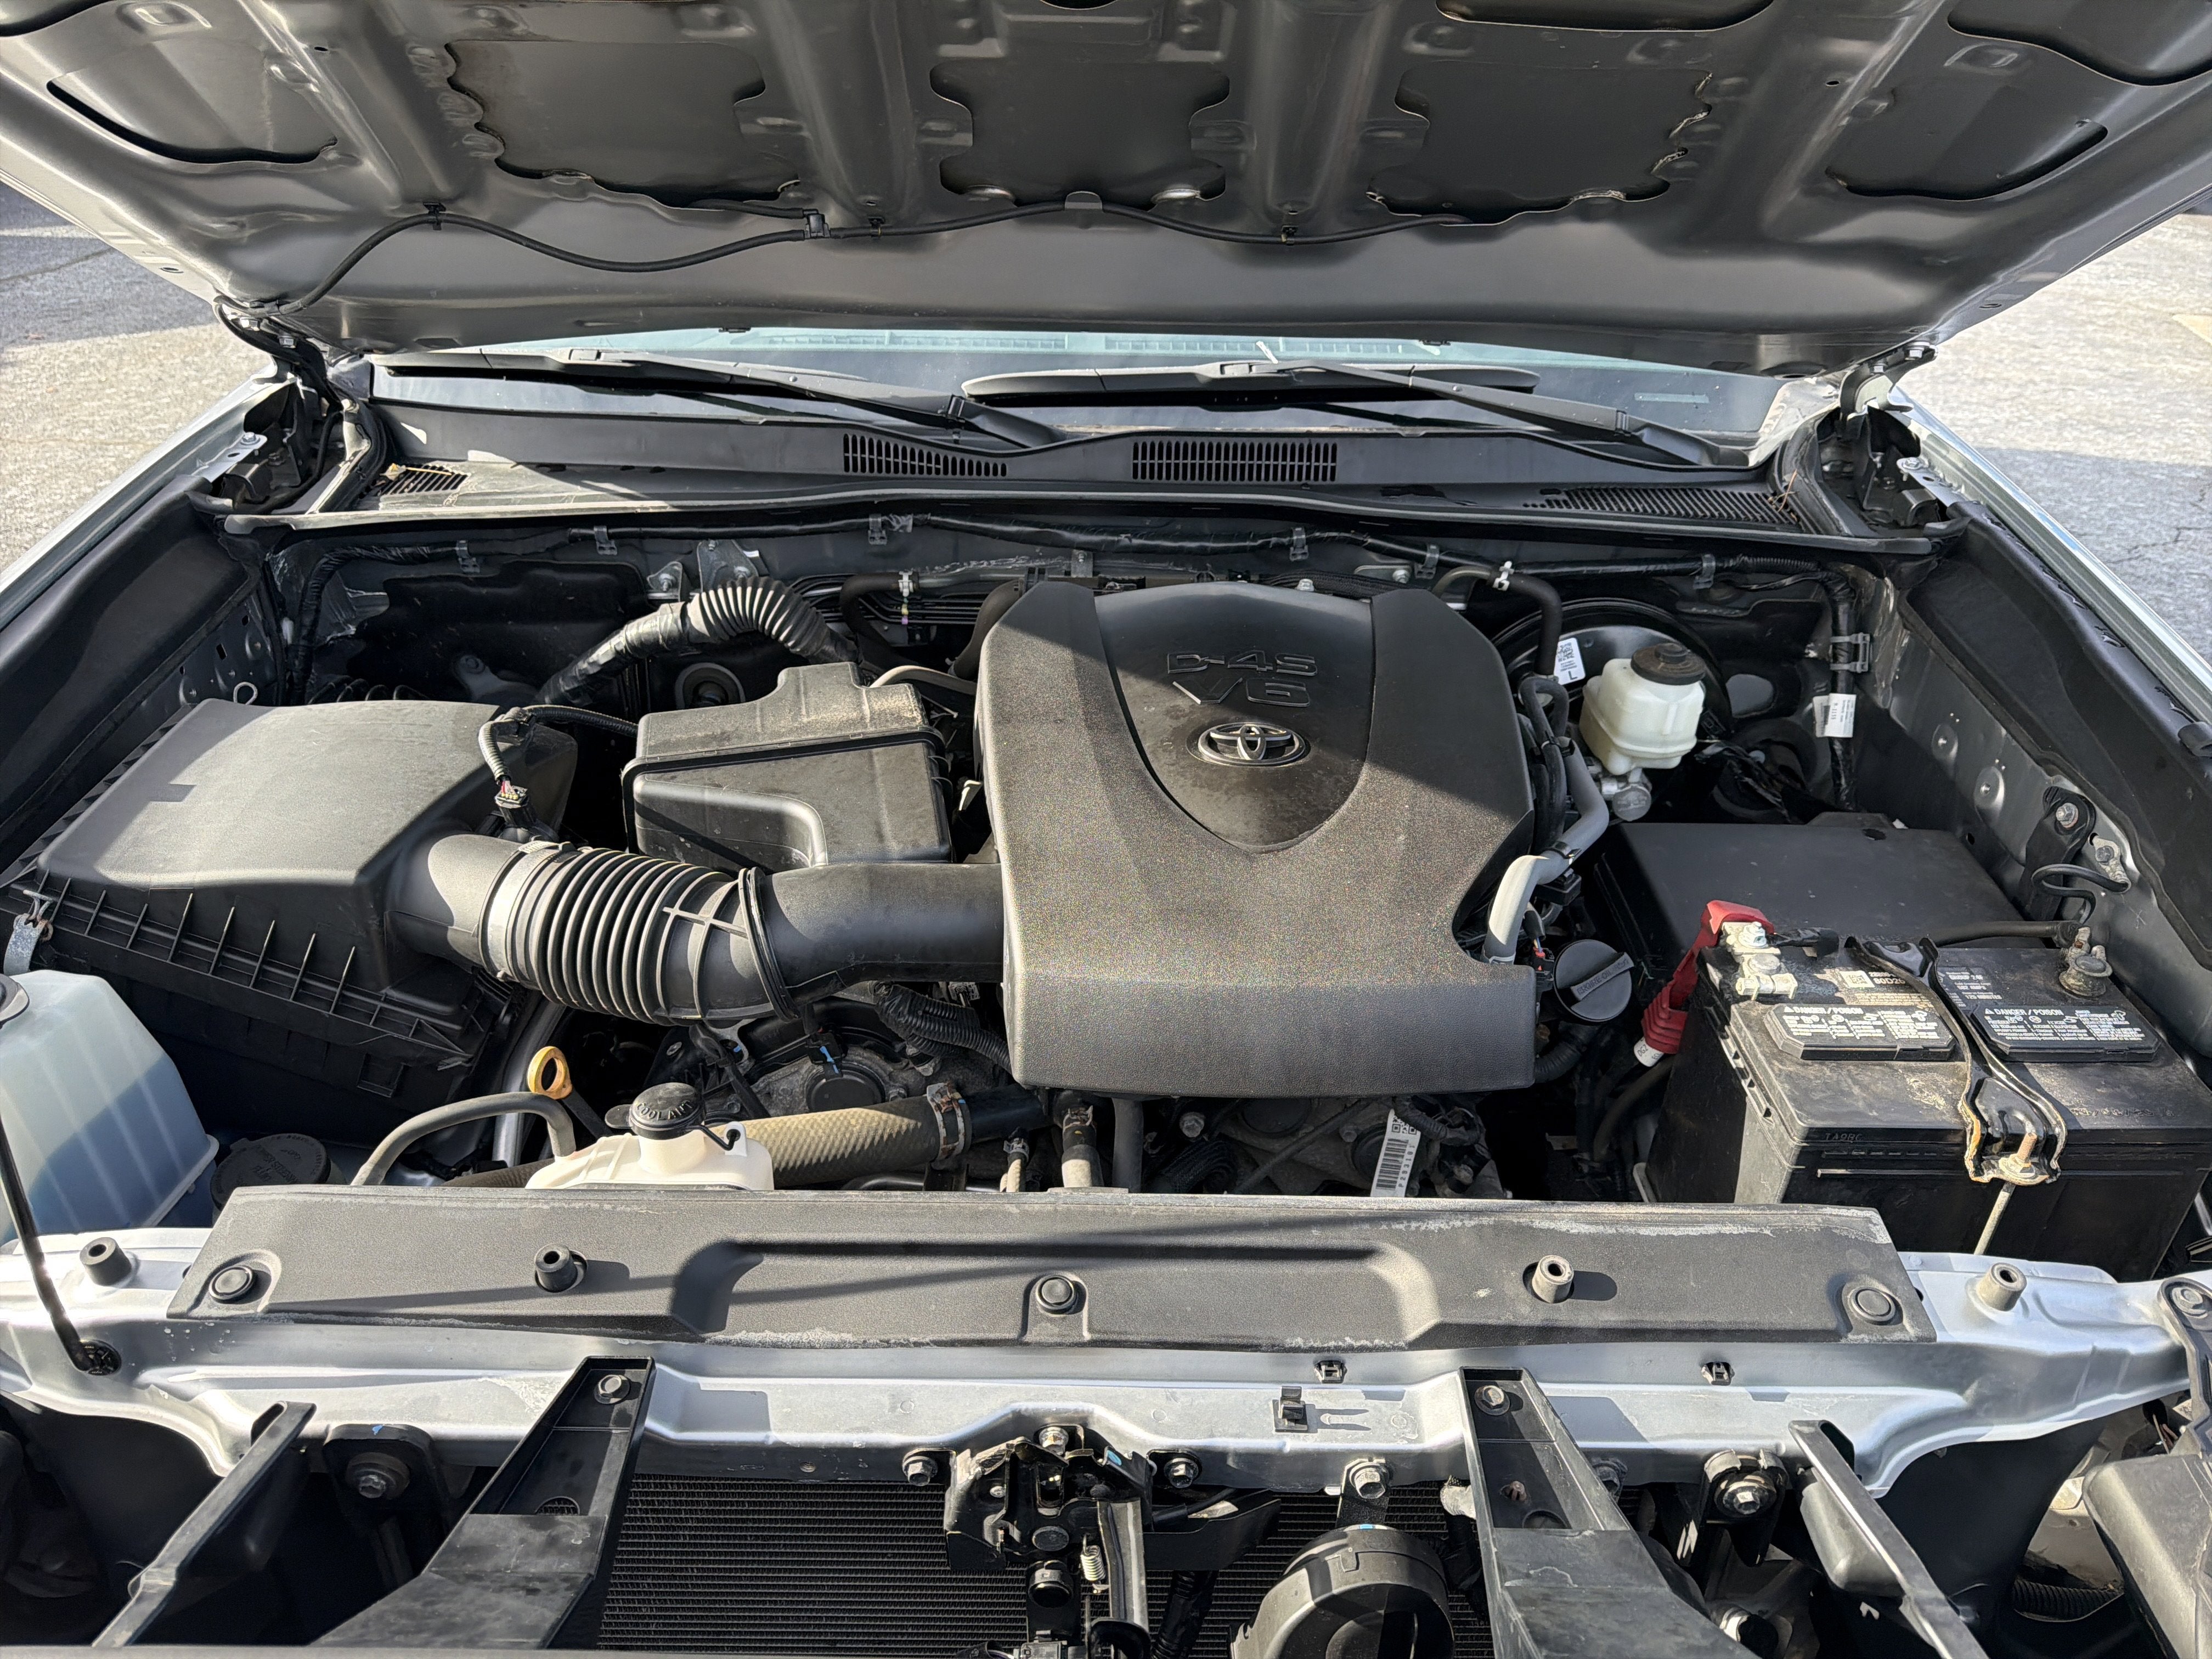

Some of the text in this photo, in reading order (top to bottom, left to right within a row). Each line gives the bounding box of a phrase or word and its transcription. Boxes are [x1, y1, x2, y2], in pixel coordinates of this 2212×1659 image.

[1167, 650, 1317, 676] D-4S
[1568, 670, 1578, 680] L
[1172, 677, 1311, 708] V6
[637, 1099, 693, 1121] COOLANT
